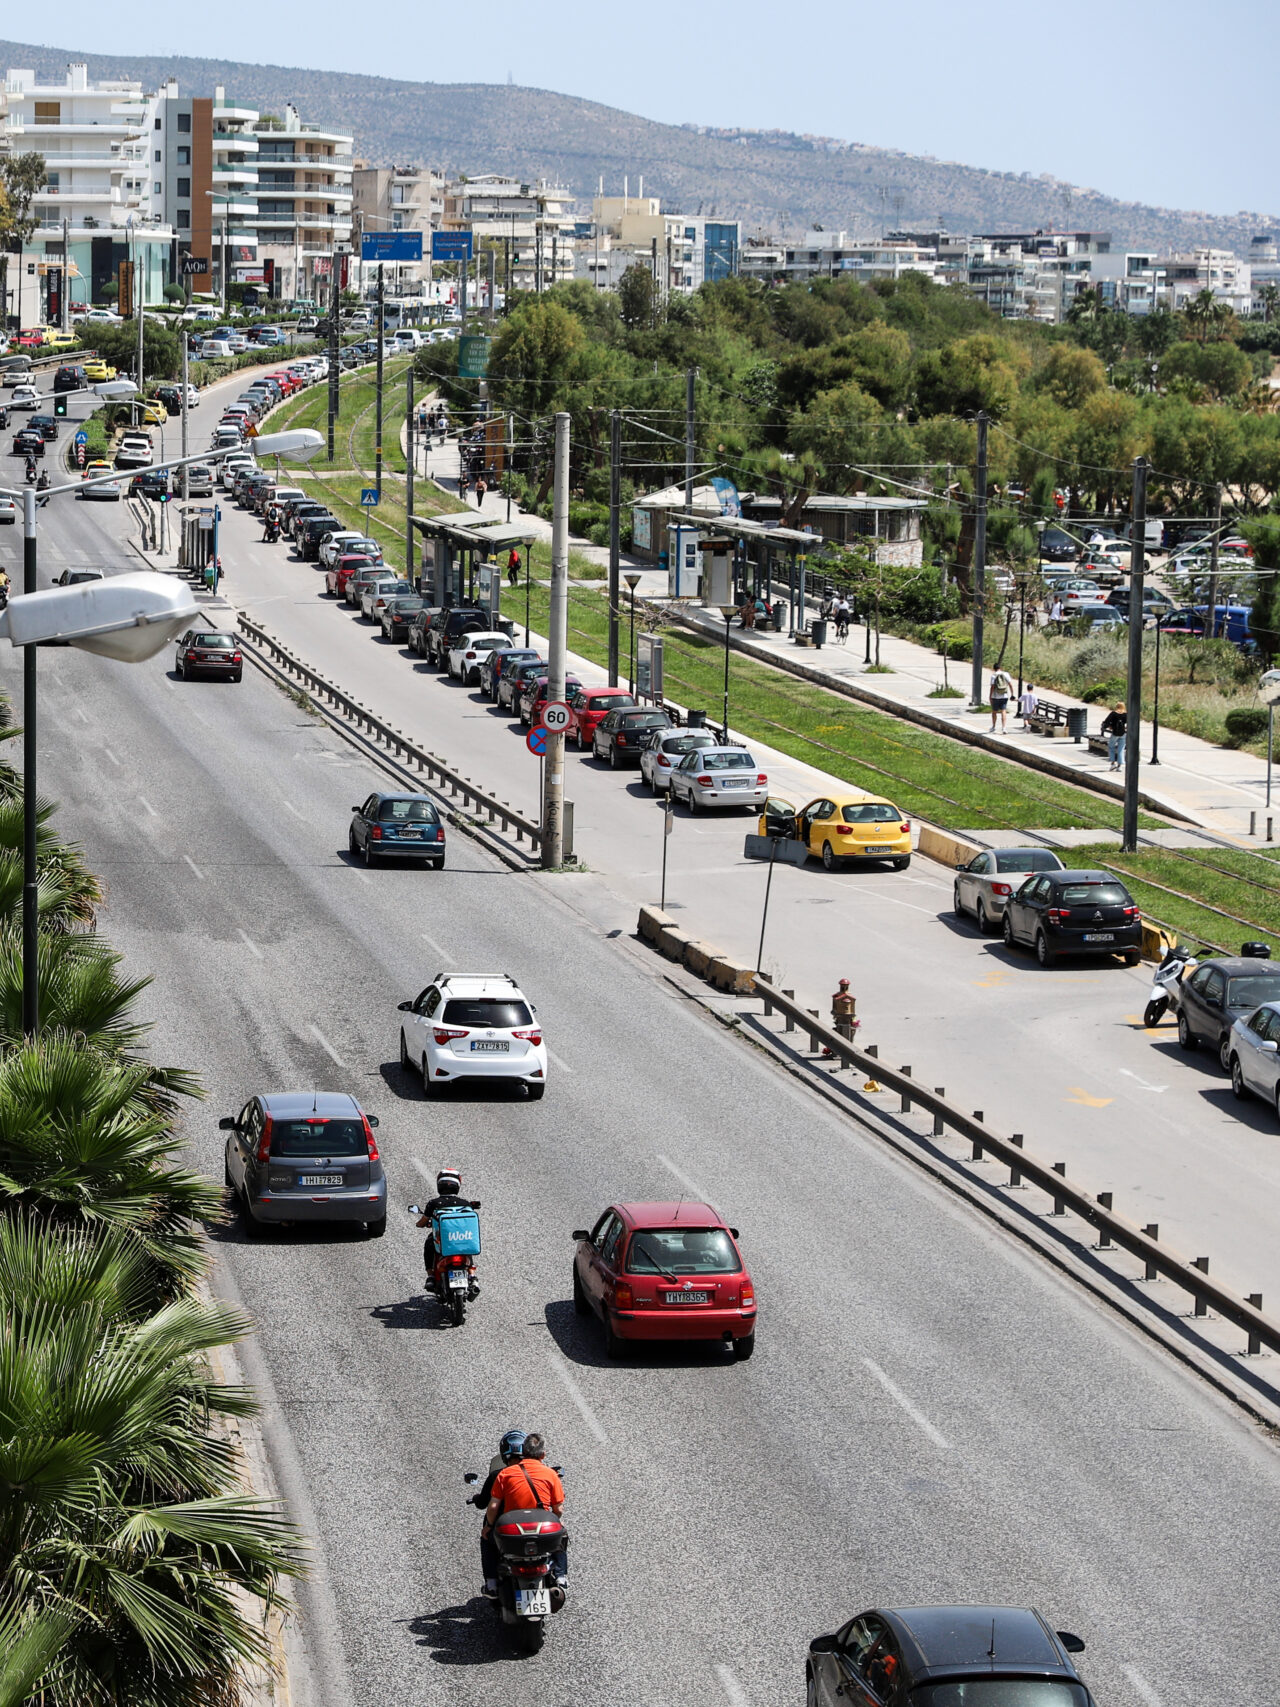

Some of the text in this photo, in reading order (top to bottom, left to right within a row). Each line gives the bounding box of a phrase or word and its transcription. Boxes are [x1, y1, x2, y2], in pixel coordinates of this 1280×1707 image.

[547, 710, 566, 724] 60
[448, 1230, 473, 1241] Wolt
[526, 1590, 545, 1600] IYY
[527, 1602, 547, 1613] 165
